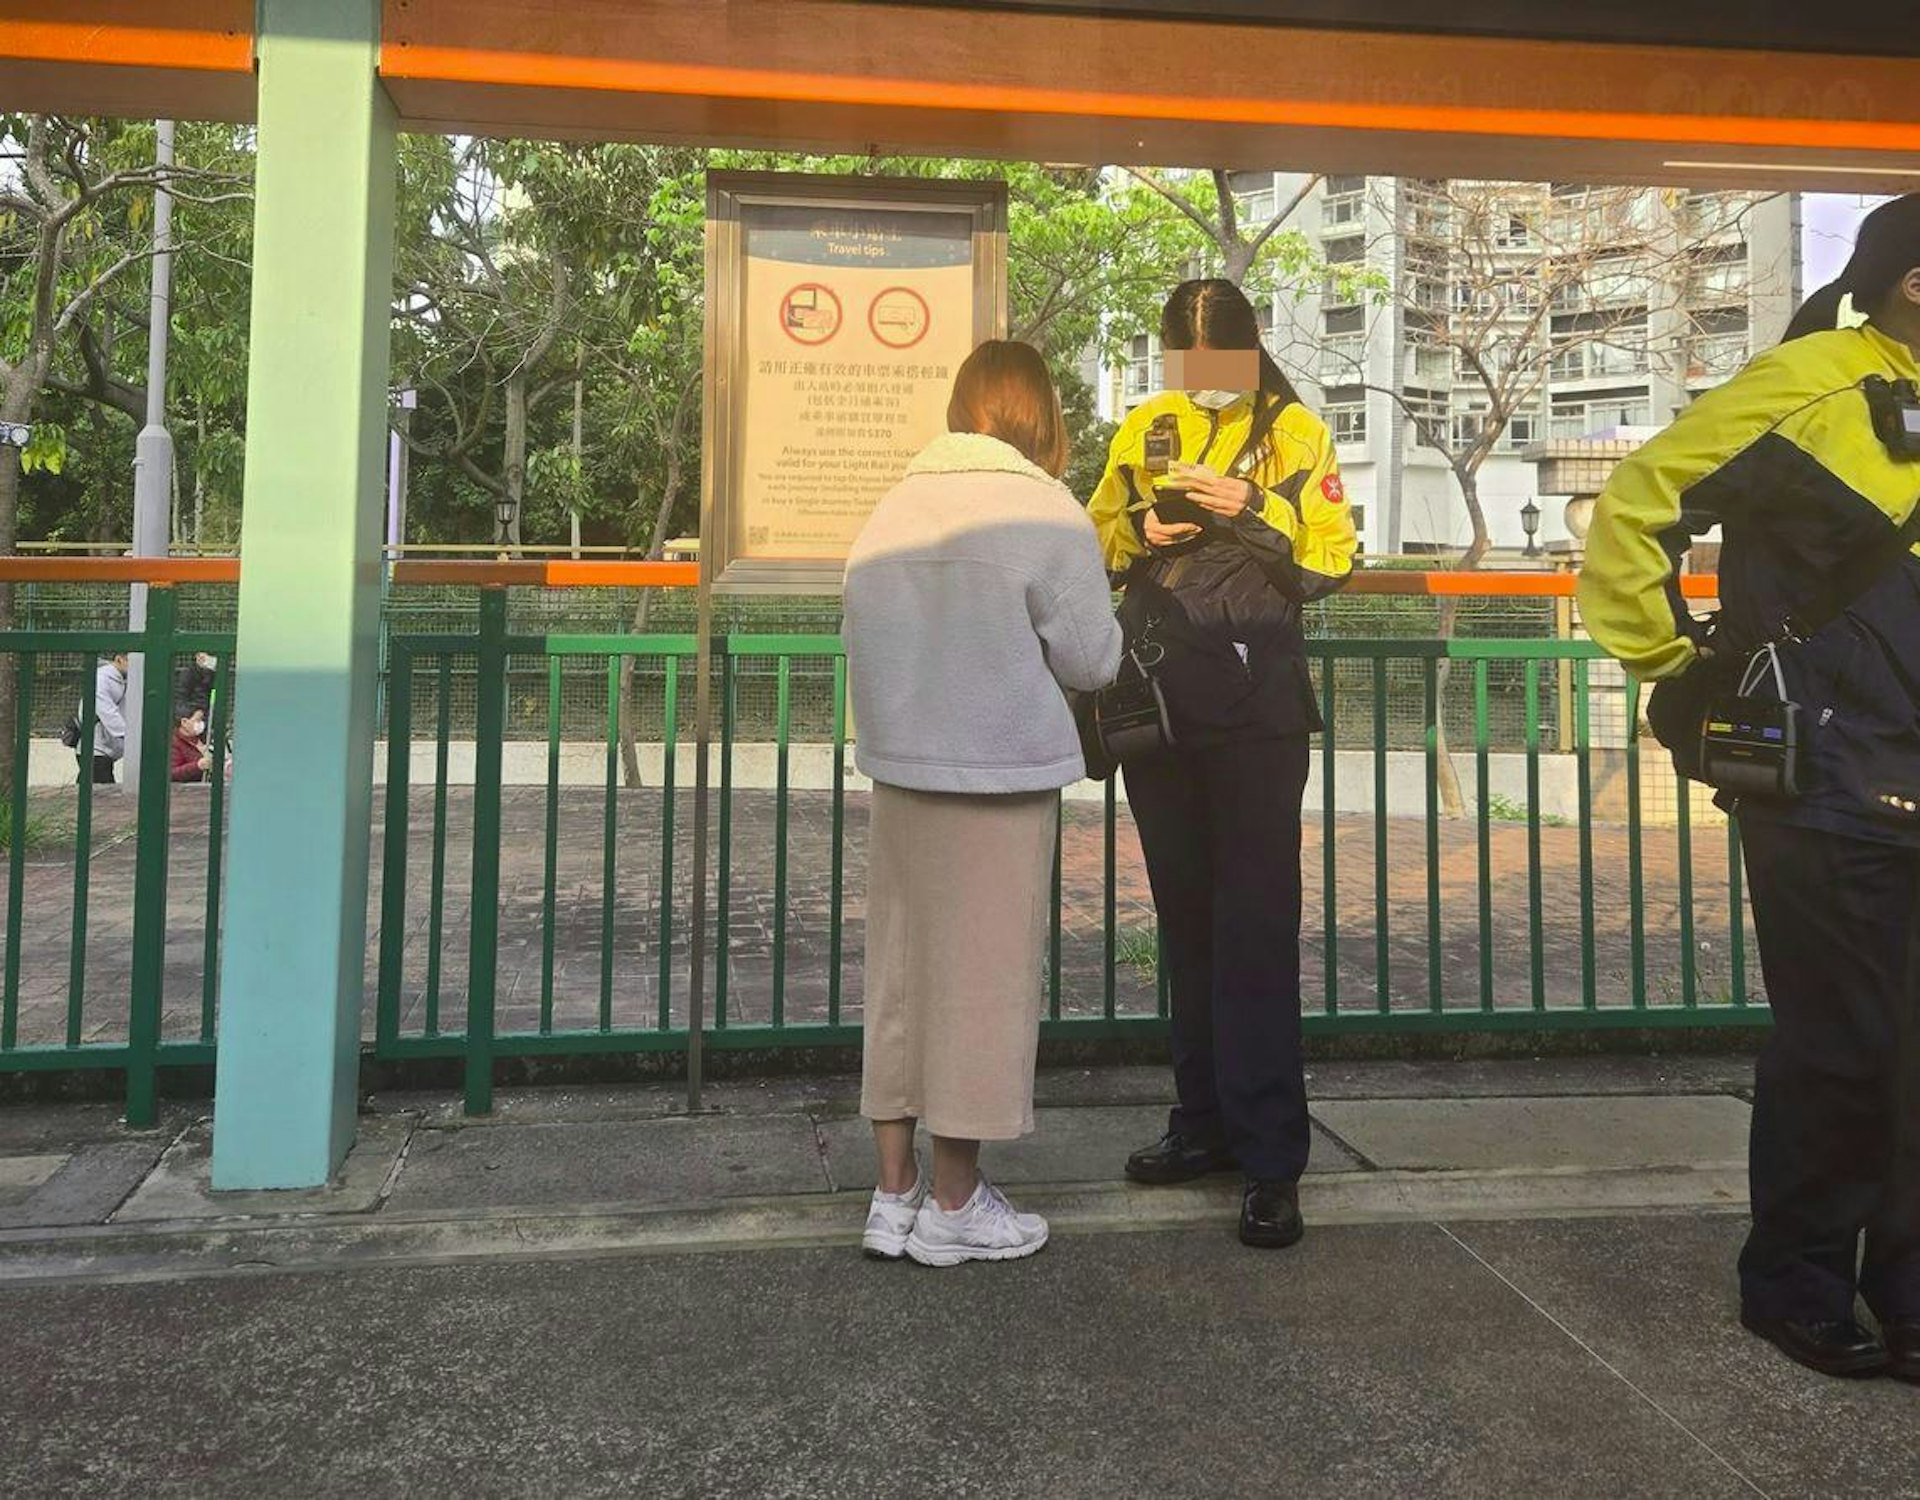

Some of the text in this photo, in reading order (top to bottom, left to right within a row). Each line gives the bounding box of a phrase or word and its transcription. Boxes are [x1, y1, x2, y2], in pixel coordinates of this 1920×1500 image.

[827, 241, 886, 258] Travel tips
[781, 446, 816, 459] Always
[818, 449, 836, 457] use
[838, 447, 855, 457] the
[857, 449, 892, 459] correct
[776, 458, 801, 468] valid
[802, 459, 816, 469] for
[818, 460, 841, 471] your
[843, 459, 869, 471] Light
